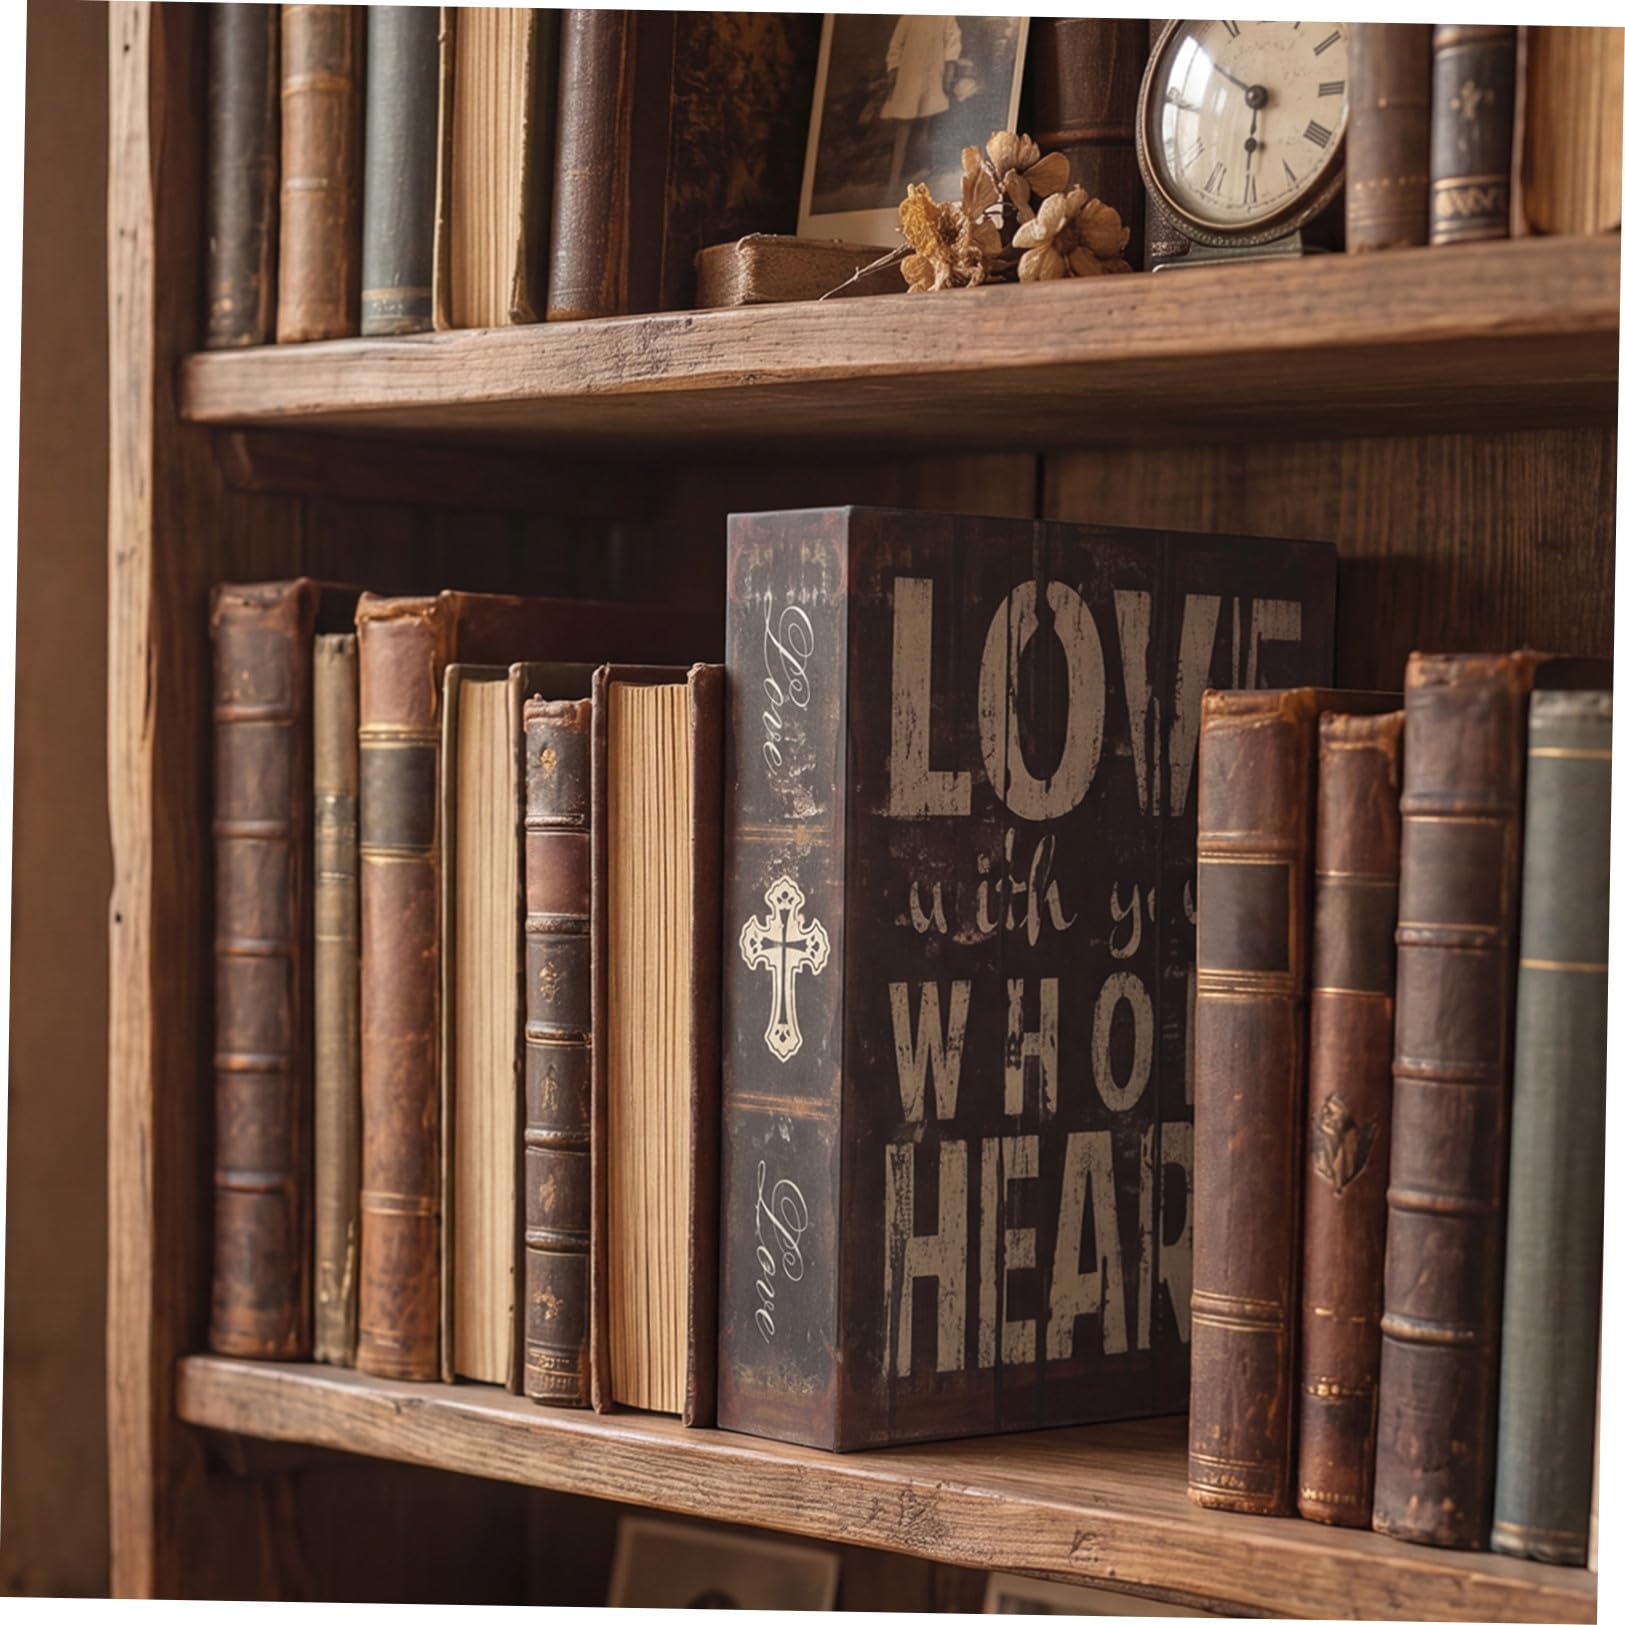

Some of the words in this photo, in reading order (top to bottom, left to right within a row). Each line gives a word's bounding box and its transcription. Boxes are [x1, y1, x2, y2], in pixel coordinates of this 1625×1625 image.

[763, 591, 814, 776] Love
[889, 971, 1196, 1121] WHO
[755, 1160, 808, 1343] Love
